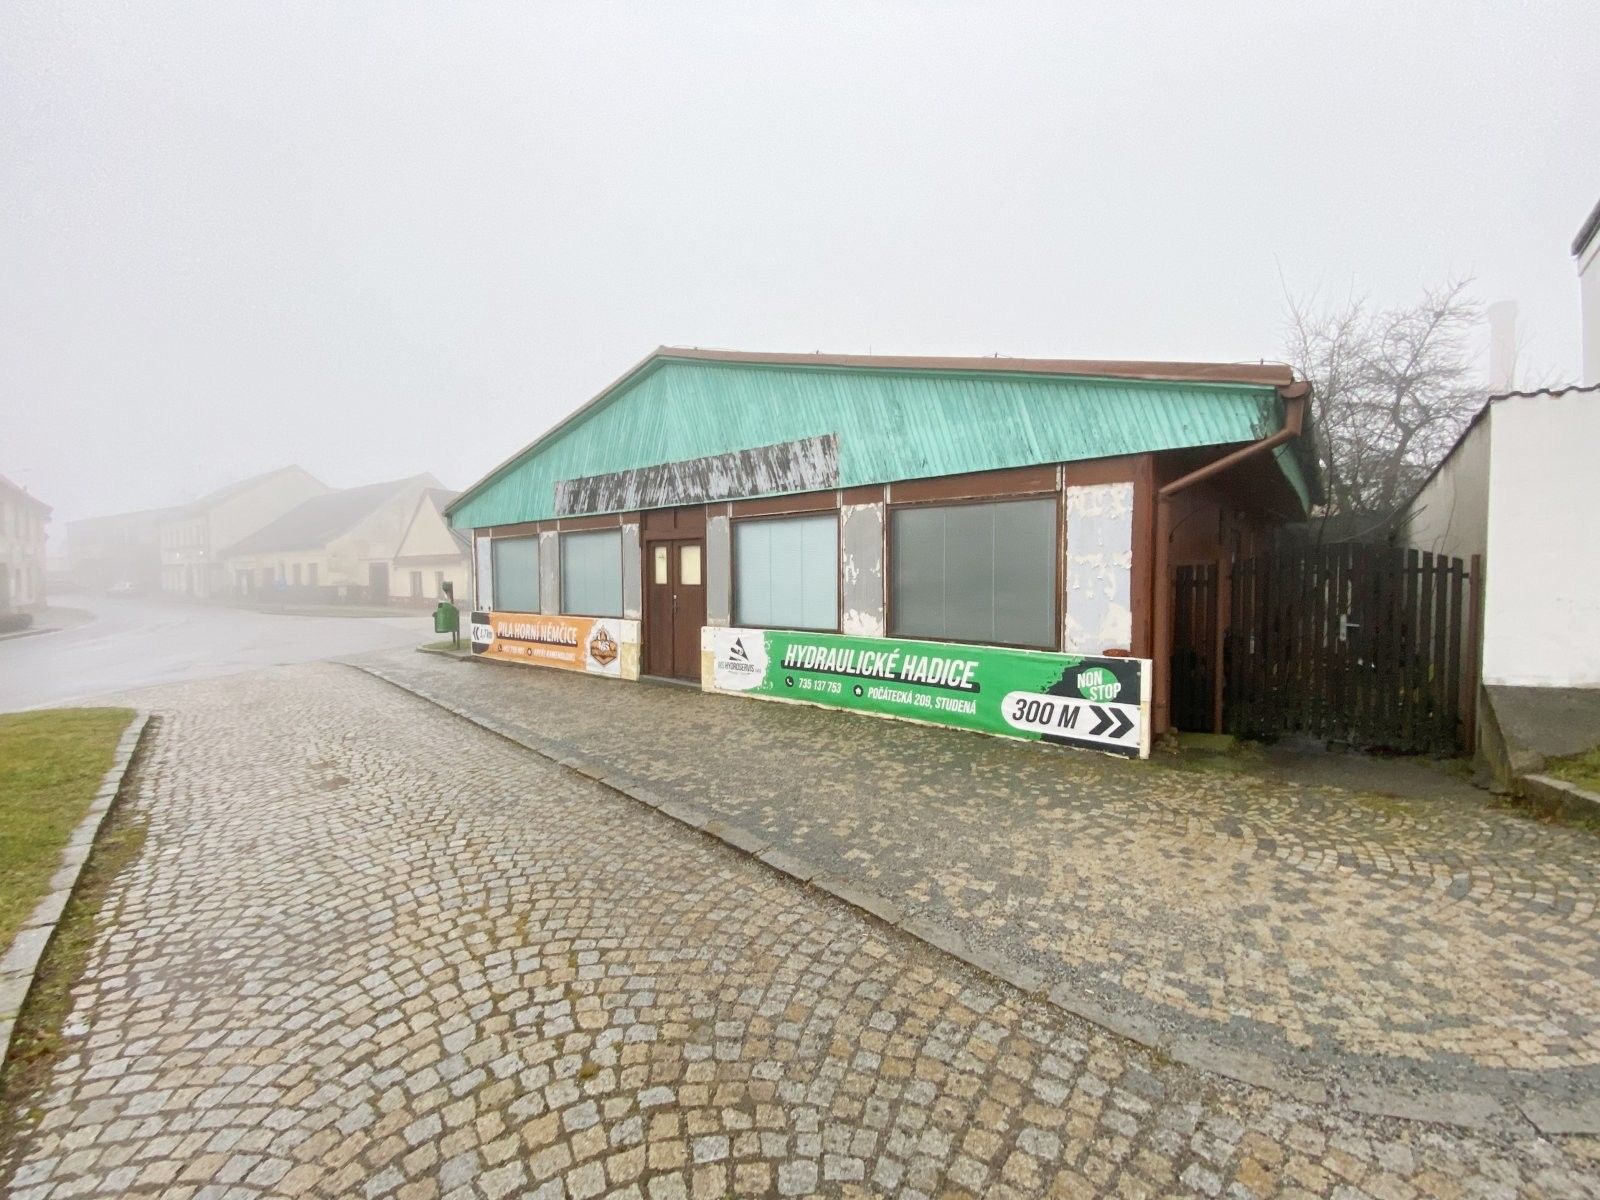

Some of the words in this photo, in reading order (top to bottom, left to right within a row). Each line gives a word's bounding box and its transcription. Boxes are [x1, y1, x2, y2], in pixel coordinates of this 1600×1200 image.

[497, 622, 513, 637] PILA
[515, 621, 540, 640] HORNÍ
[541, 622, 578, 644] NĚMČICE
[725, 662, 754, 672] HYDROSERVIS
[784, 644, 900, 687] HYDRAULICKÉ
[901, 654, 979, 688] HADICE
[799, 678, 812, 689] 735
[814, 680, 825, 691] 137
[827, 682, 842, 693] 753
[1077, 671, 1102, 688] NON
[868, 687, 912, 704] POČÁTECKÁ
[914, 694, 932, 708] 209,
[935, 697, 976, 714] STUDENÁ
[1090, 683, 1121, 700] STOP
[1012, 699, 1054, 725] 300
[1057, 704, 1080, 729] M
